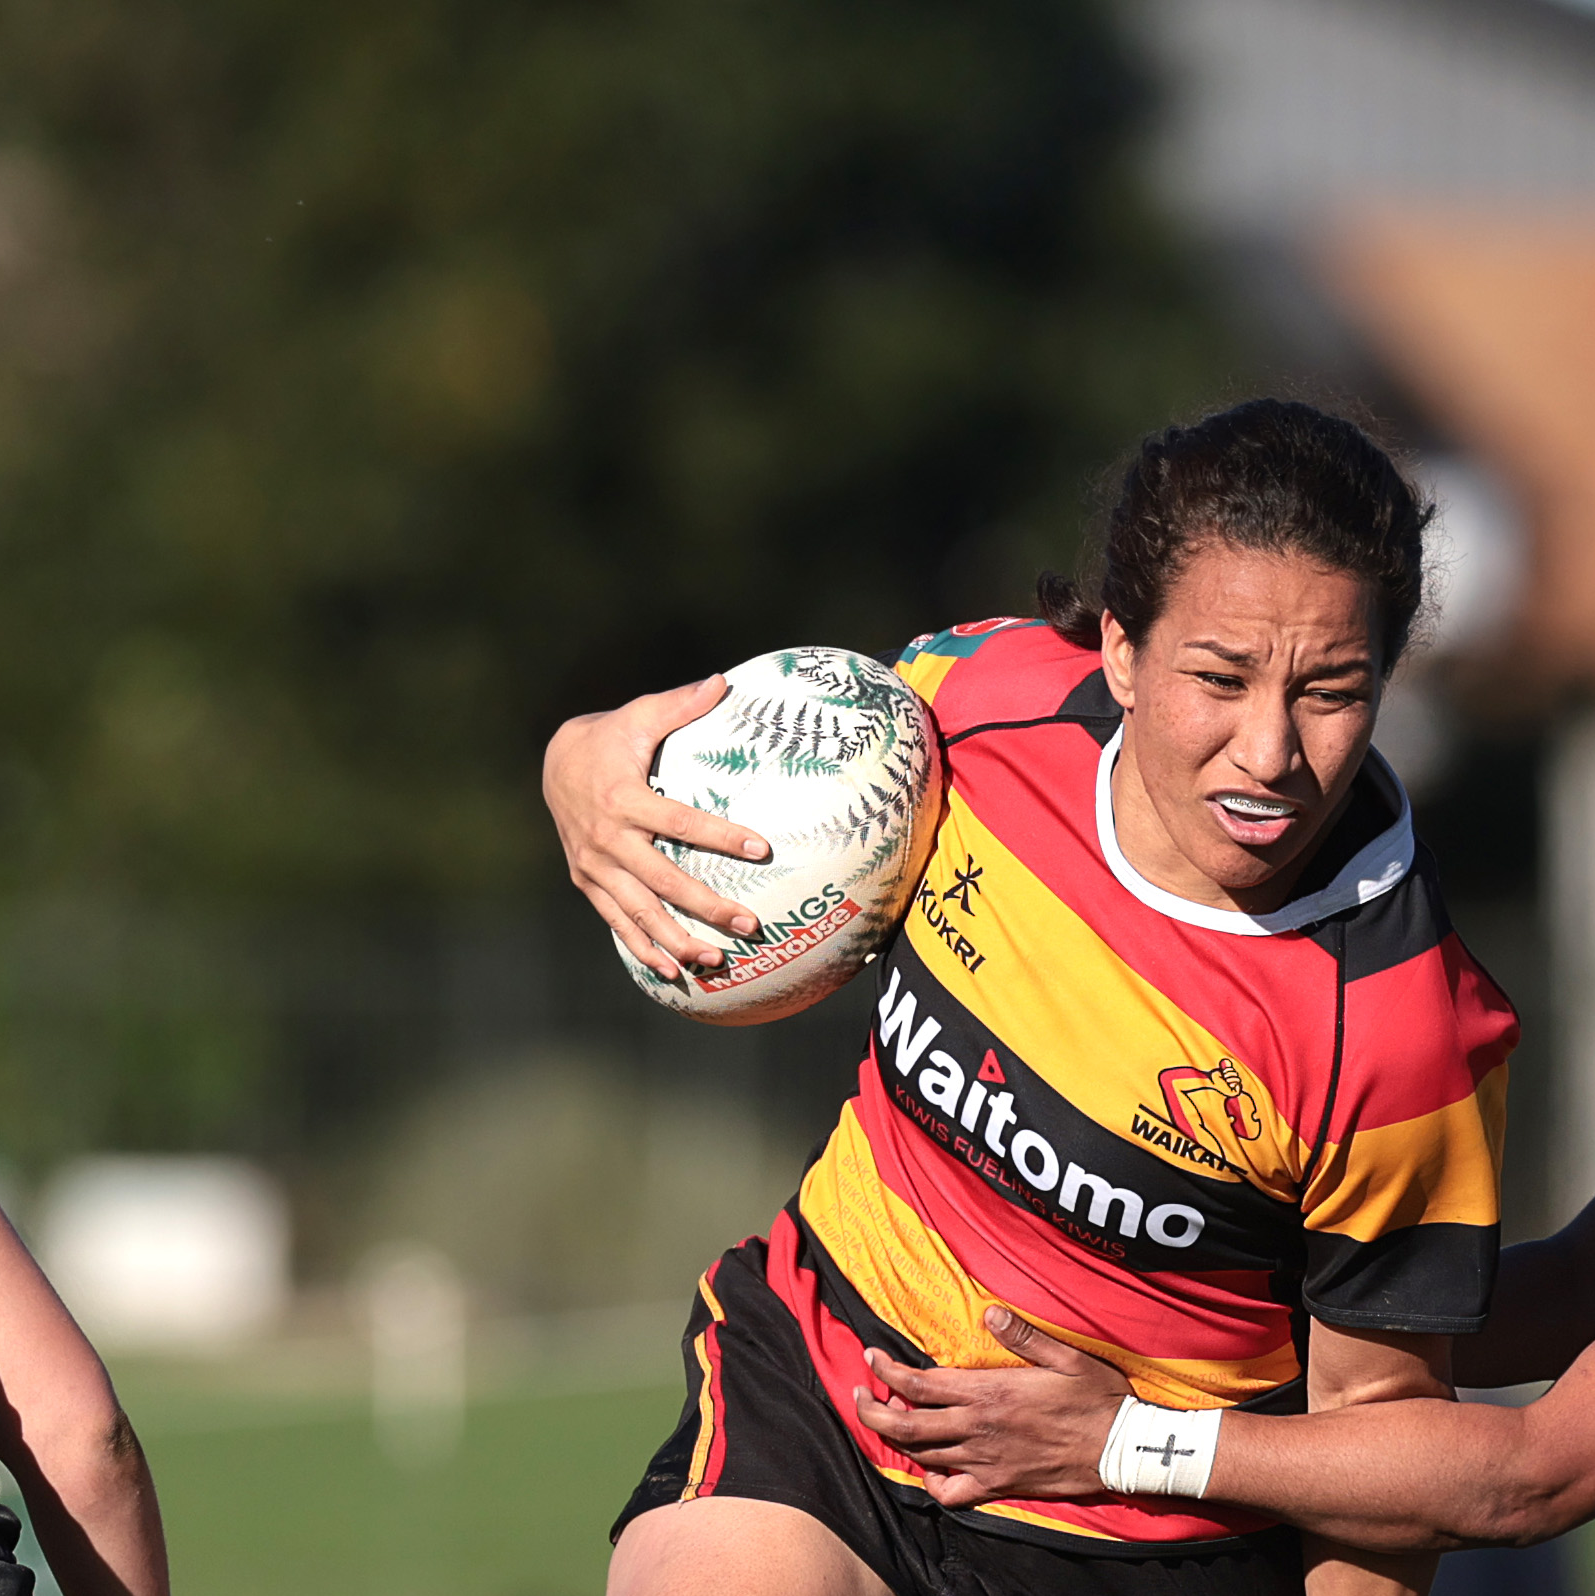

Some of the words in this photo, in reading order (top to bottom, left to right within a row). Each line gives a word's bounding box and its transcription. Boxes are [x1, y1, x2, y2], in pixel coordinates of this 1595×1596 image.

[1229, 797, 1283, 812] EMPOWERED
[707, 907, 851, 990] warehouse
[916, 878, 987, 975] KUKRI
[878, 967, 1203, 1248] Waitomo
[895, 1083, 950, 1145] KIWIS
[1131, 1113, 1234, 1173] WAIKAT
